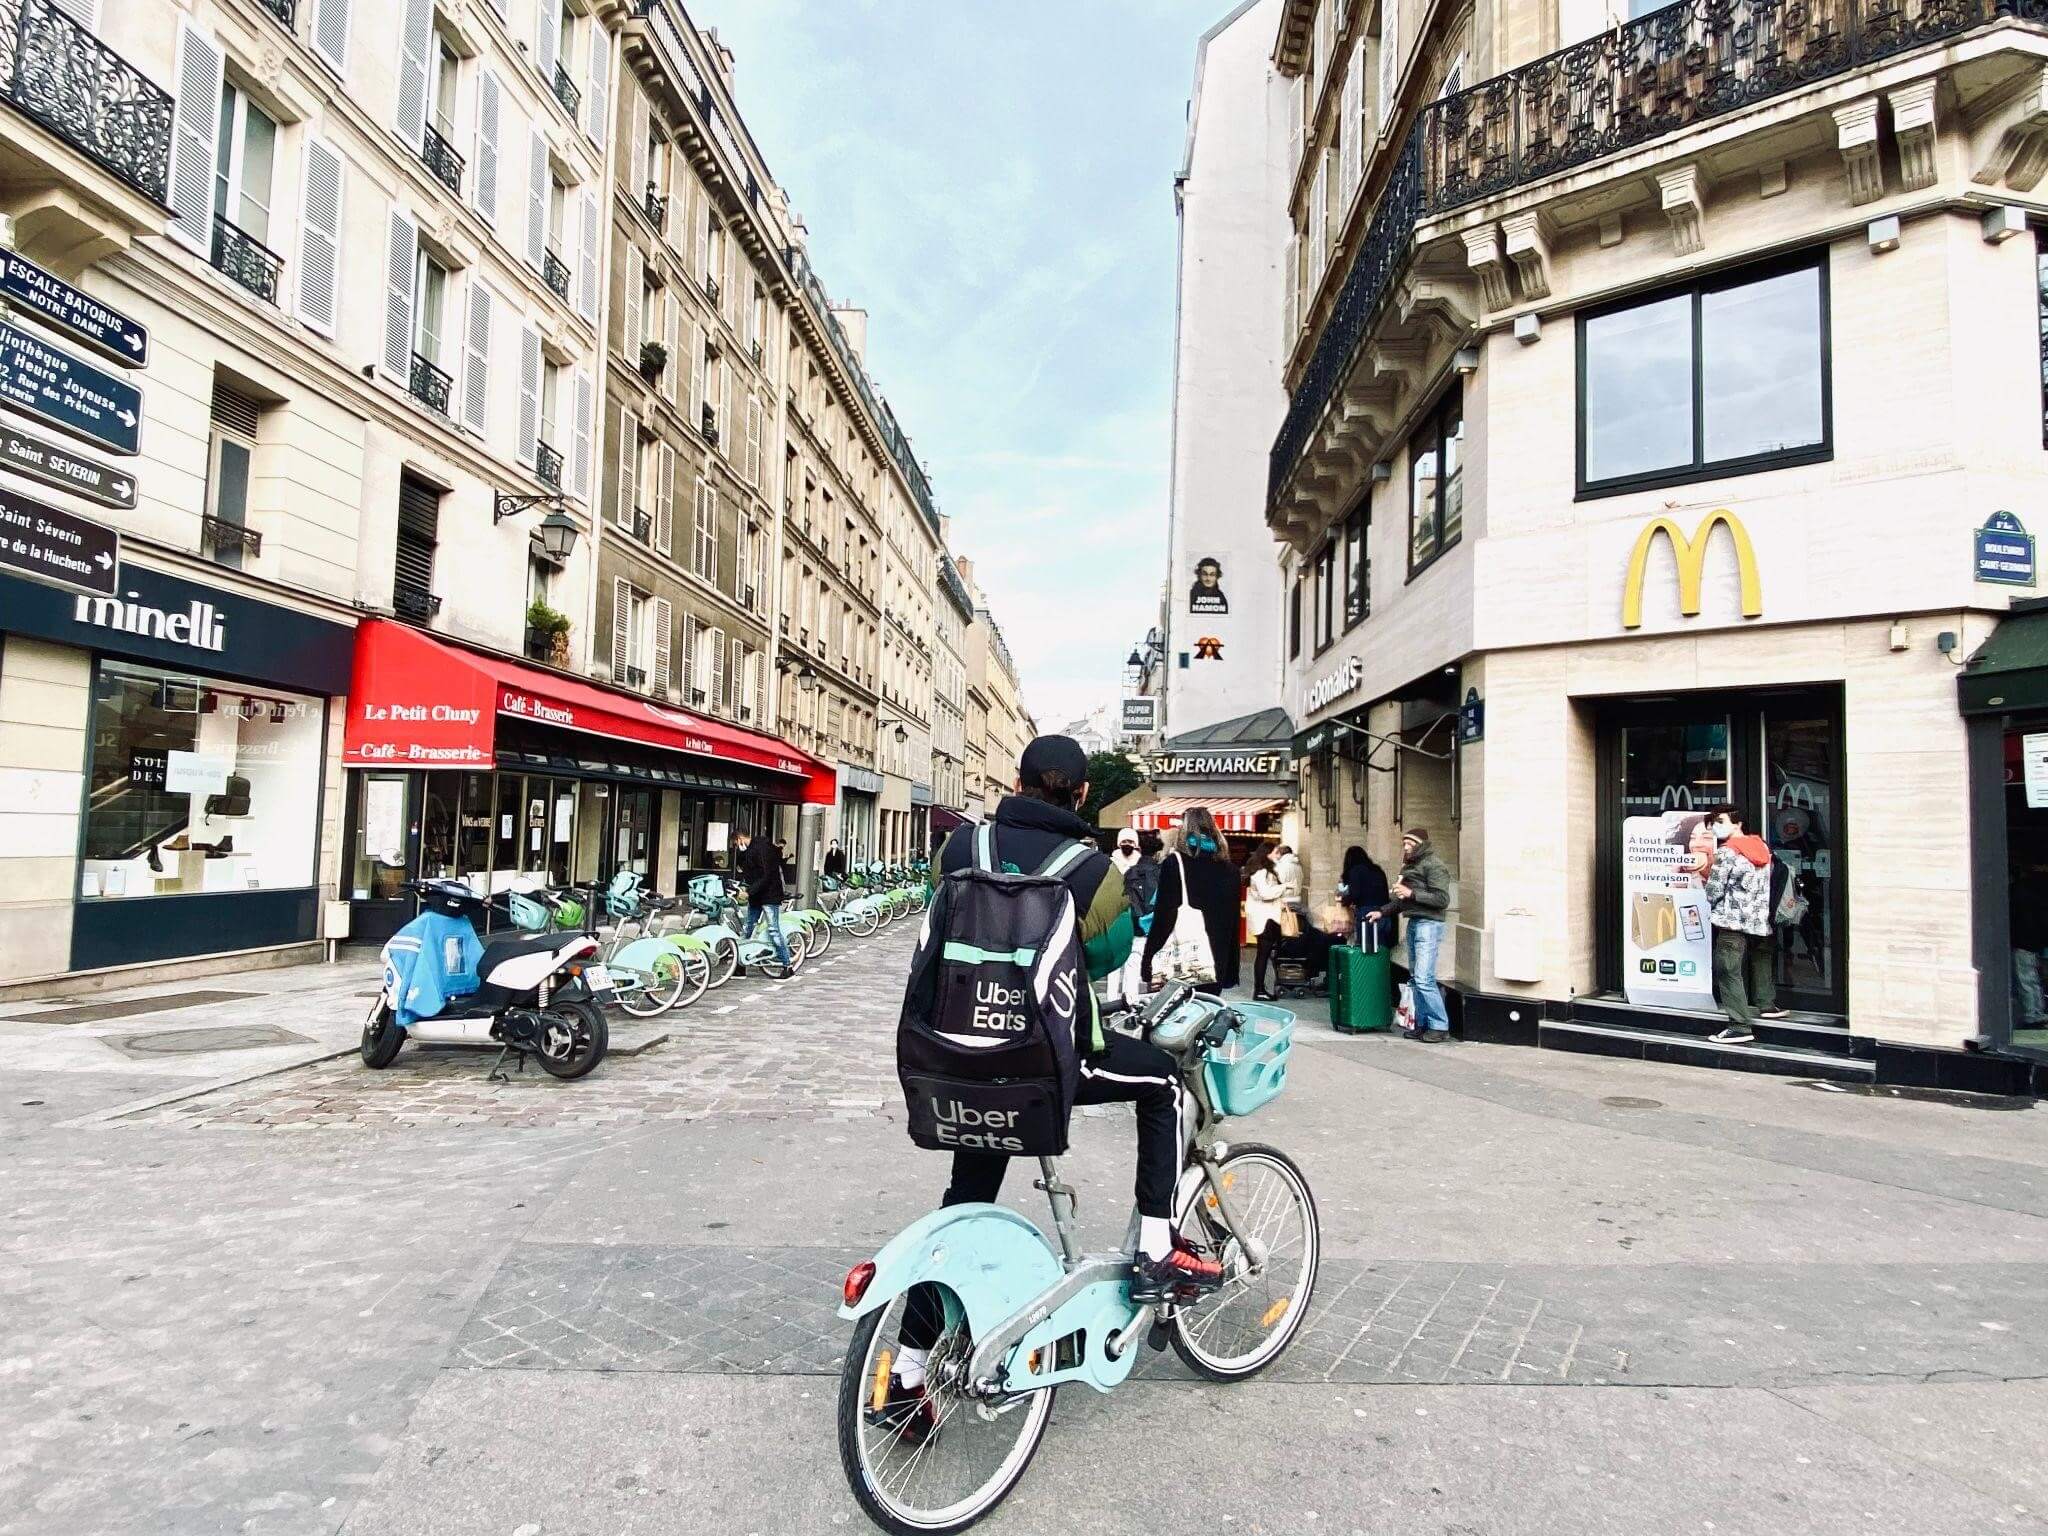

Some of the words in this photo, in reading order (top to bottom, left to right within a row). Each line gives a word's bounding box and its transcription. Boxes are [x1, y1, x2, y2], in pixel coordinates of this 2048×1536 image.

[8, 259, 123, 332] ESCALE-BATOBUS
[28, 289, 68, 318] NOTRE
[72, 313, 105, 338] DAME
[0, 327, 69, 372] liothèque
[0, 380, 35, 404] éverin
[14, 352, 57, 383] Heure
[62, 377, 116, 411] Joyeuse
[18, 373, 39, 391] Rue
[42, 386, 61, 402] des
[9, 439, 43, 465] Saint
[49, 455, 101, 486] SEVERIN
[0, 504, 31, 529] Saint
[36, 518, 82, 546] Séverin
[12, 539, 27, 554] de
[30, 544, 41, 559] la
[43, 548, 92, 575] Huchette
[73, 591, 226, 652] minelli
[364, 704, 386, 720] Le
[390, 704, 427, 721] Petit
[431, 705, 480, 725] Cluny
[504, 692, 527, 714] Café
[535, 700, 574, 725] Brasserie
[1122, 716, 1153, 725] MARKET
[1126, 705, 1150, 714] SUPER
[361, 743, 397, 759] Café
[408, 744, 481, 760] Brasserie
[1153, 756, 1281, 774] SUPERMARKET
[132, 770, 163, 782] DES
[1639, 837, 1661, 845] tout
[1628, 855, 1696, 864] commandez
[1643, 873, 1689, 883] livraison
[976, 980, 1026, 1006] Uber
[972, 1005, 1026, 1032] Eats
[931, 1096, 1020, 1129] Uber
[935, 1123, 1024, 1152] Eats
